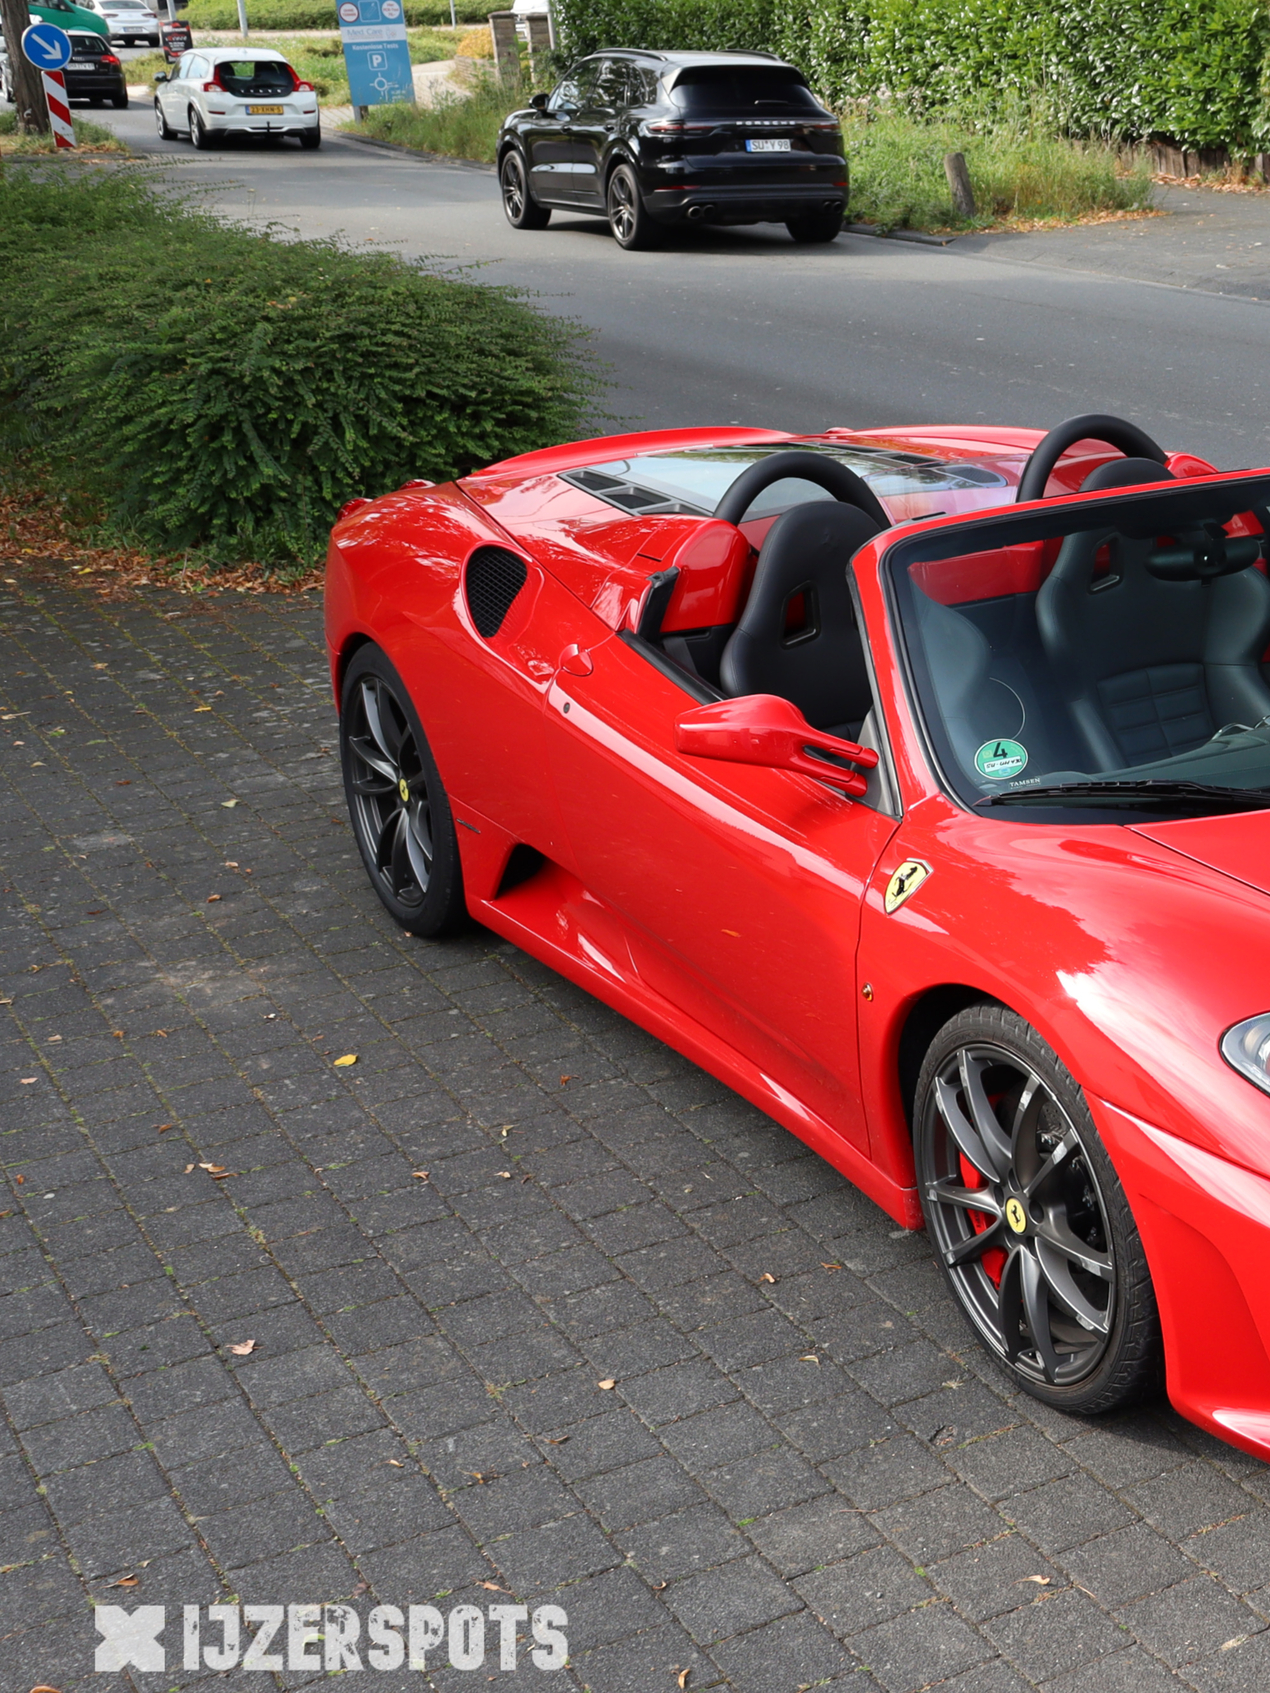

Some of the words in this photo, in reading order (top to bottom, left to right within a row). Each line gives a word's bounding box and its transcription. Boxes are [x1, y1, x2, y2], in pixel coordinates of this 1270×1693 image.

[752, 141, 764, 150] SU
[778, 141, 789, 150] 98
[993, 742, 1008, 758] 4
[1010, 778, 1040, 787] TAMSEN
